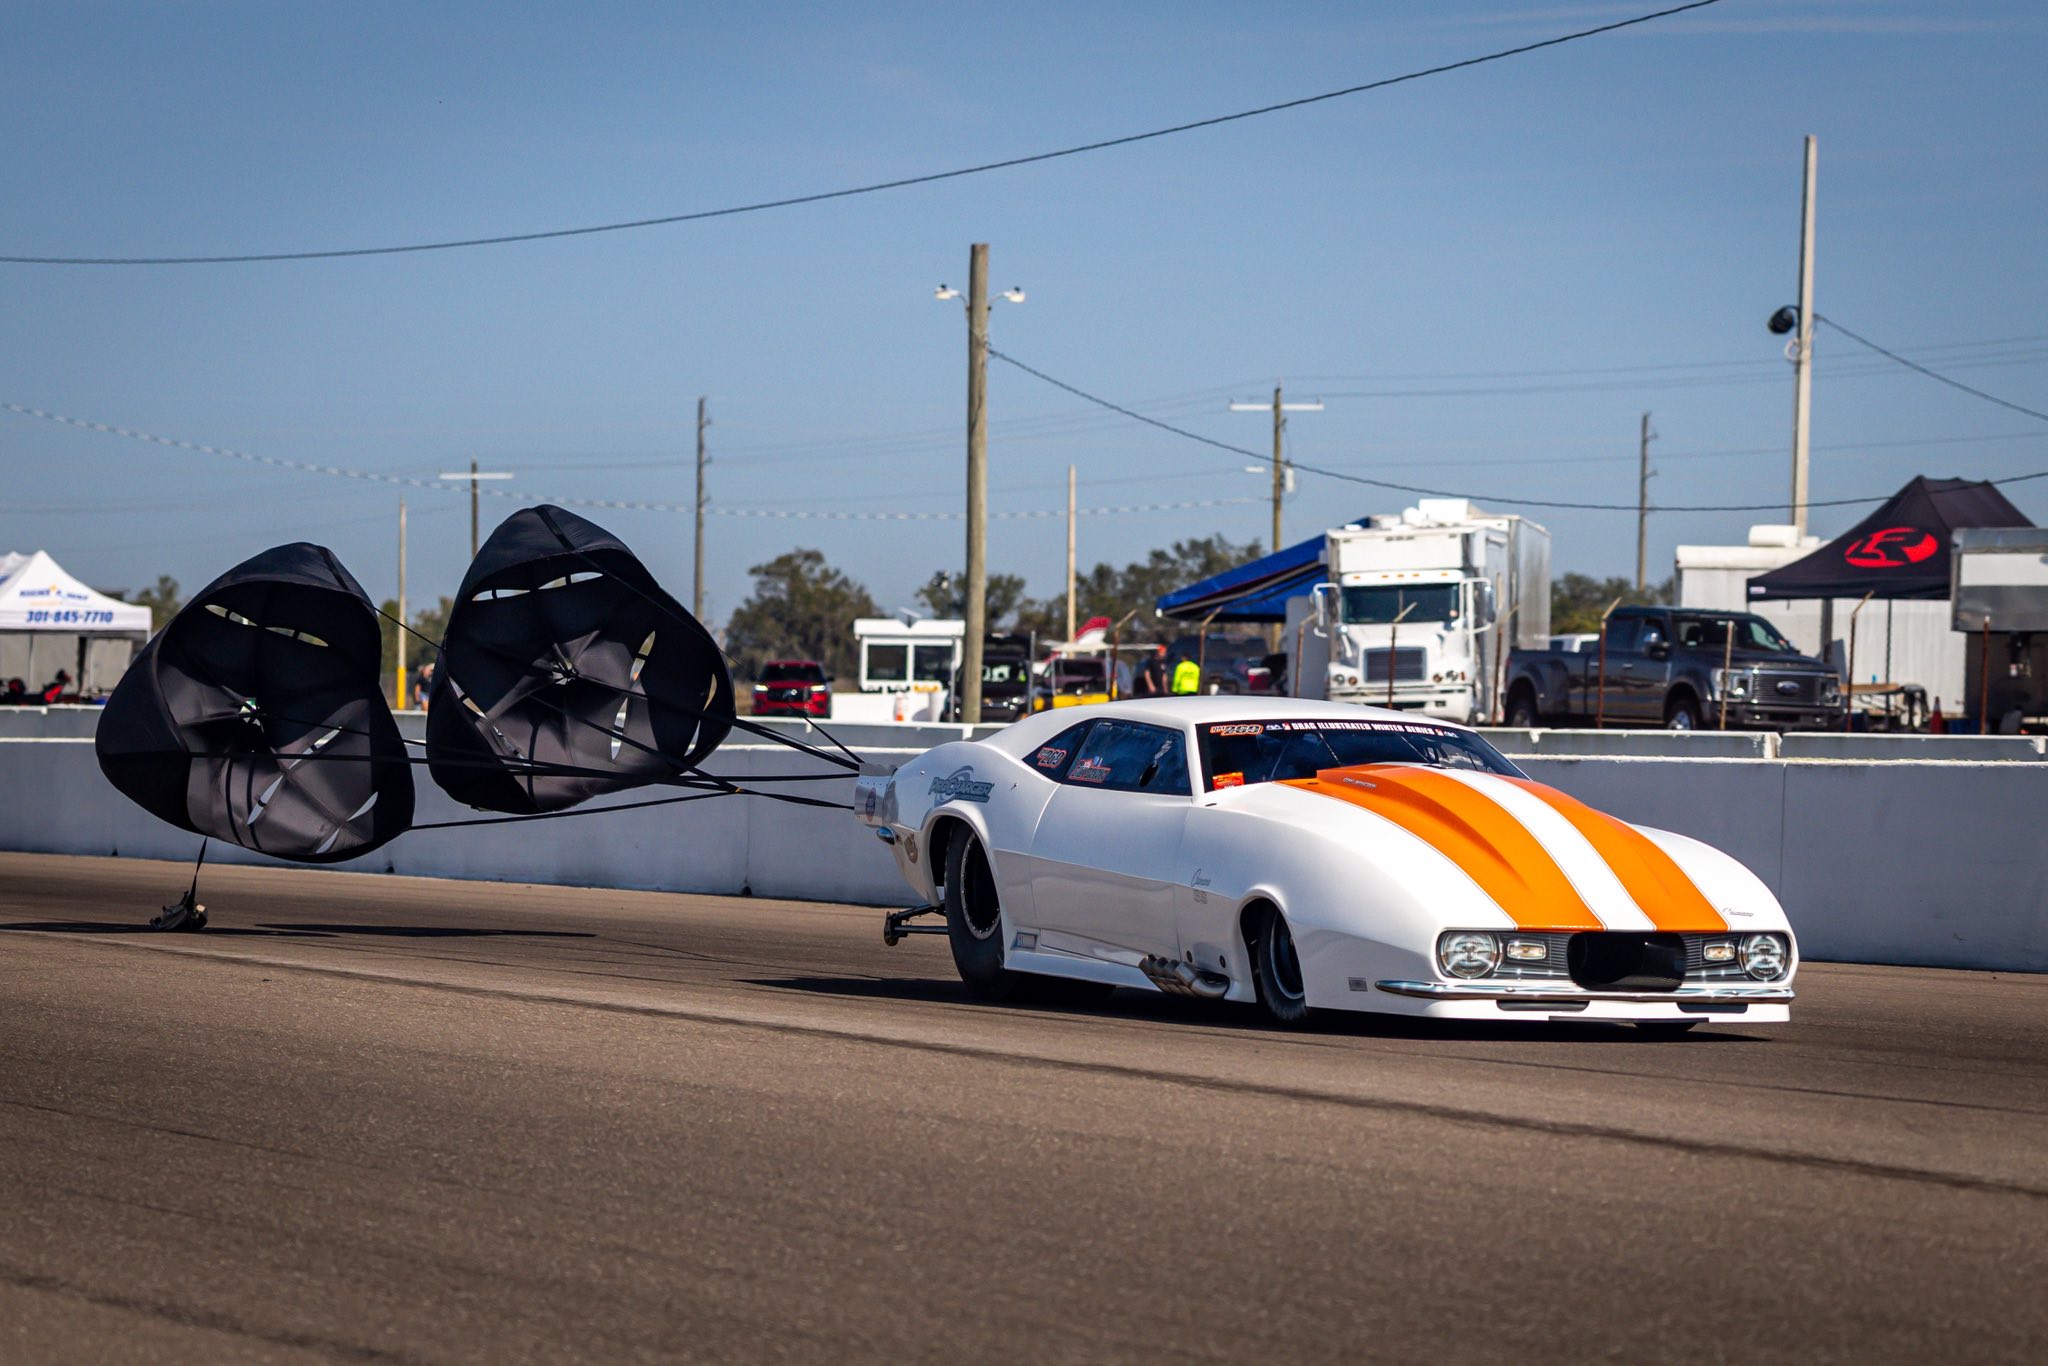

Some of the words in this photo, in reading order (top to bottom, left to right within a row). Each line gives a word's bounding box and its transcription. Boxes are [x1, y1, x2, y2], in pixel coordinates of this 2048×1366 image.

[26, 610, 114, 623] 301-845-7710
[1291, 722, 1318, 730] DRAG
[1317, 722, 1371, 730] ILLUSTRATED
[1371, 723, 1405, 732] WINTER
[1404, 725, 1435, 735] SERIES
